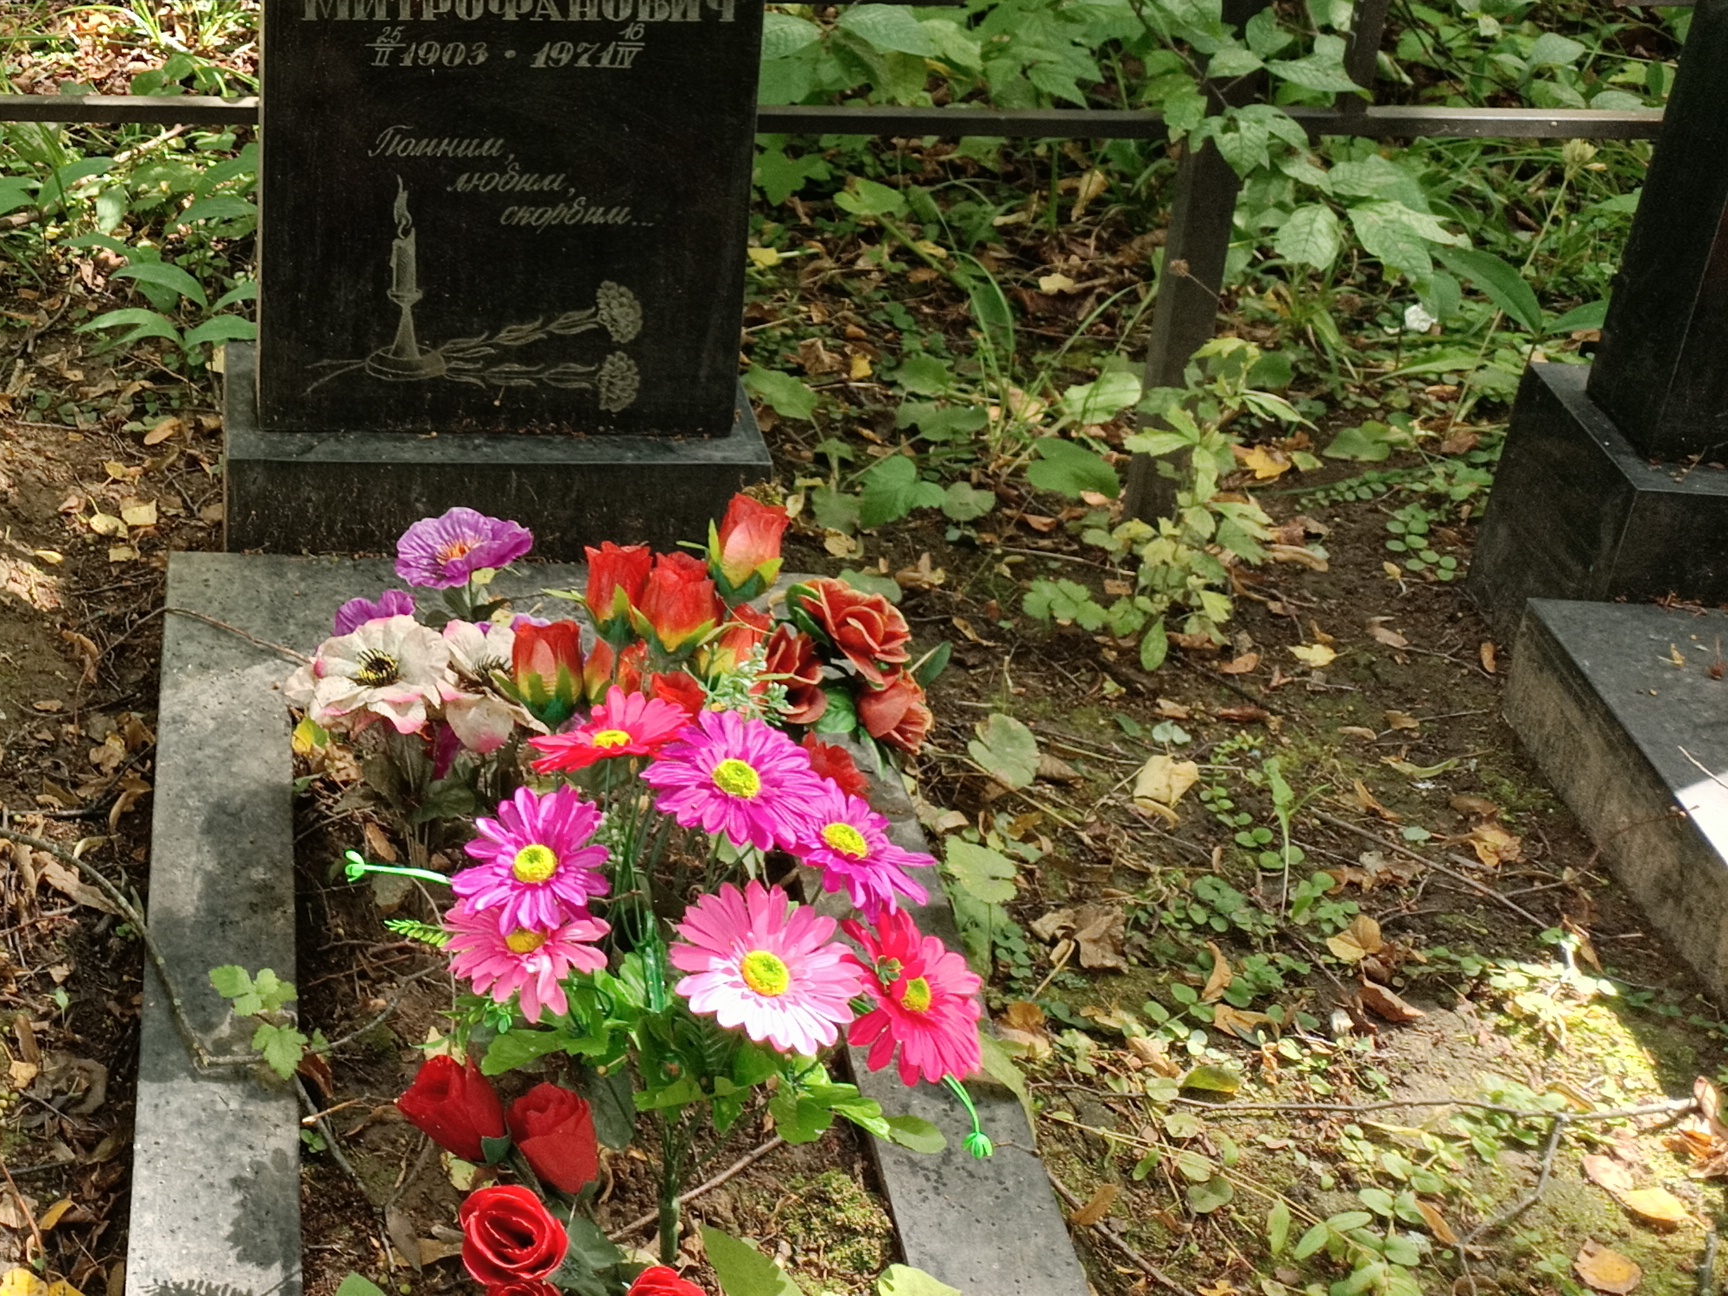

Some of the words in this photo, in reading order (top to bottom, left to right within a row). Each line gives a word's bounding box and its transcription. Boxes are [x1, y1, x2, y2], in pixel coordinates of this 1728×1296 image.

[398, 40, 489, 67] 1903
[529, 40, 618, 68] 1971
[368, 124, 515, 164] Помним,
[446, 161, 575, 197] любим,
